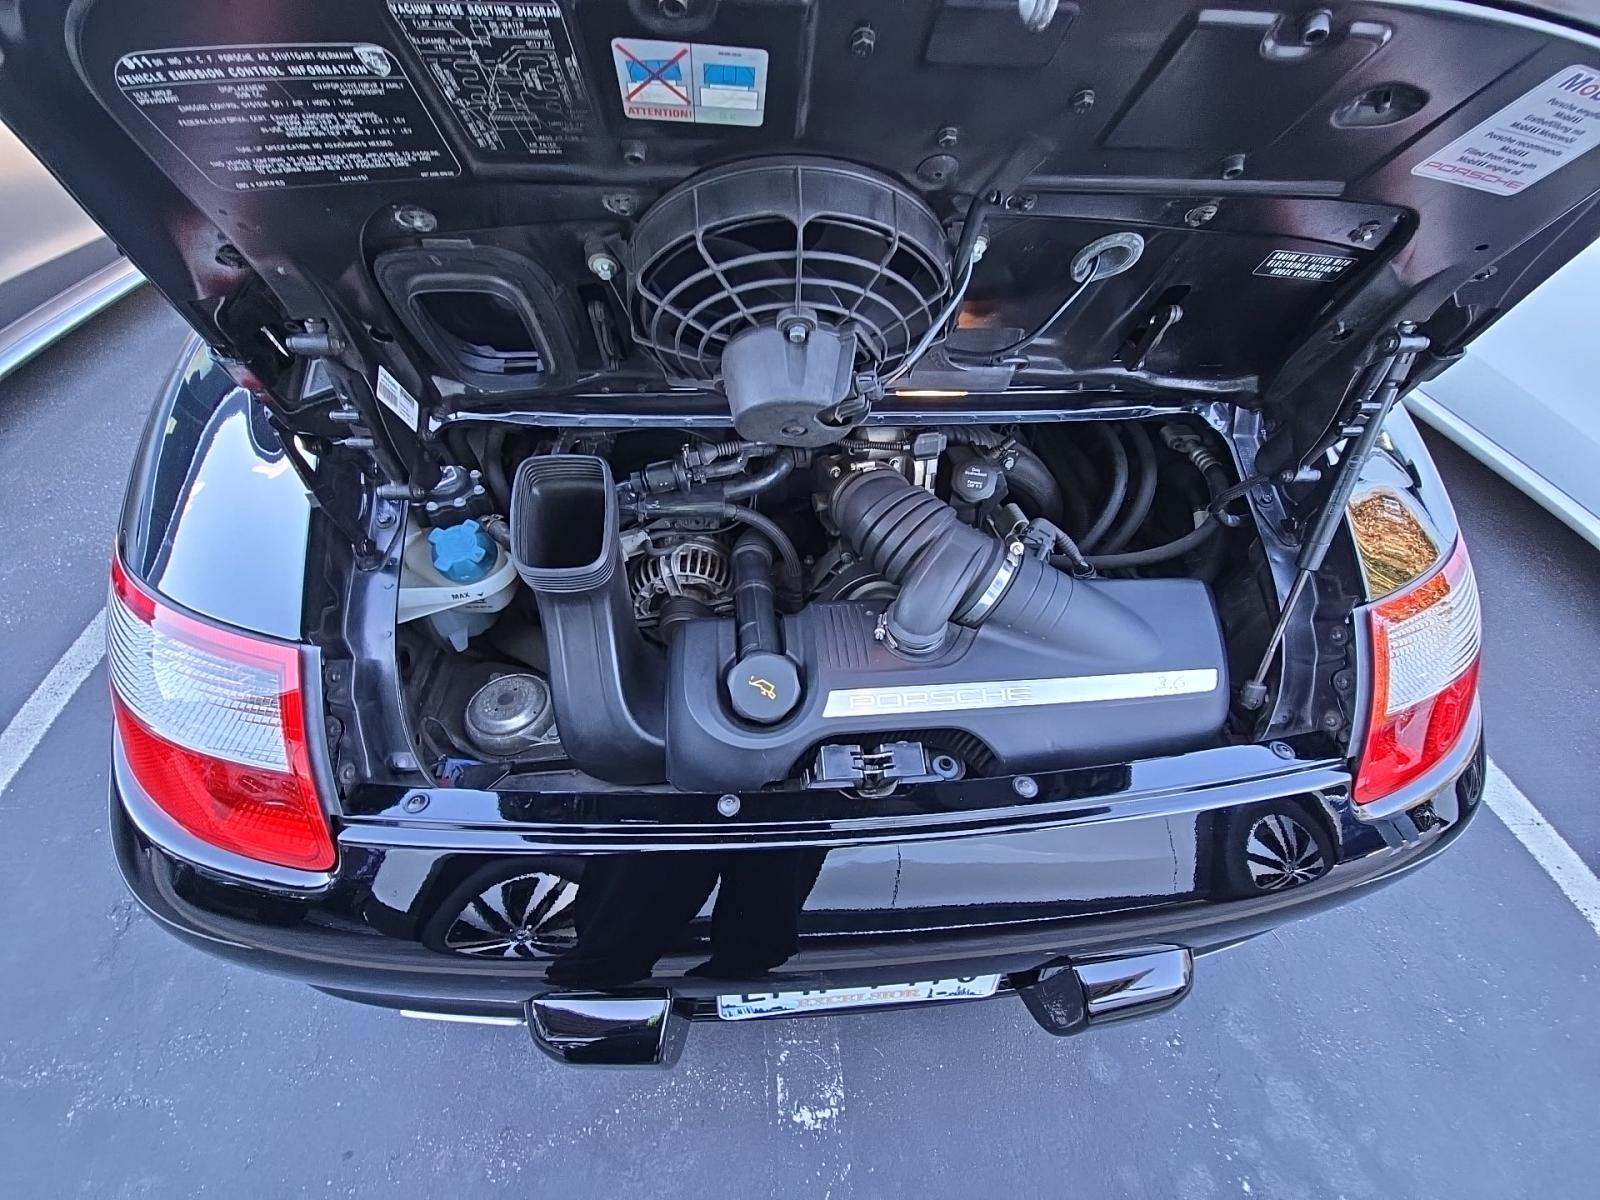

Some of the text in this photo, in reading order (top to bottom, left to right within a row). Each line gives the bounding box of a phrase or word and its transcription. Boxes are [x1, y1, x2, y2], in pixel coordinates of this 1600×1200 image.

[388, 3, 561, 18] VACUUM HOSE ROUTING DIAGRAM
[118, 64, 369, 85] VEHICLE EMISSION CONTROL INFORMATION
[1423, 161, 1525, 190] PORSCHE
[451, 592, 471, 600] MAX
[849, 686, 1034, 709] PORSCHE
